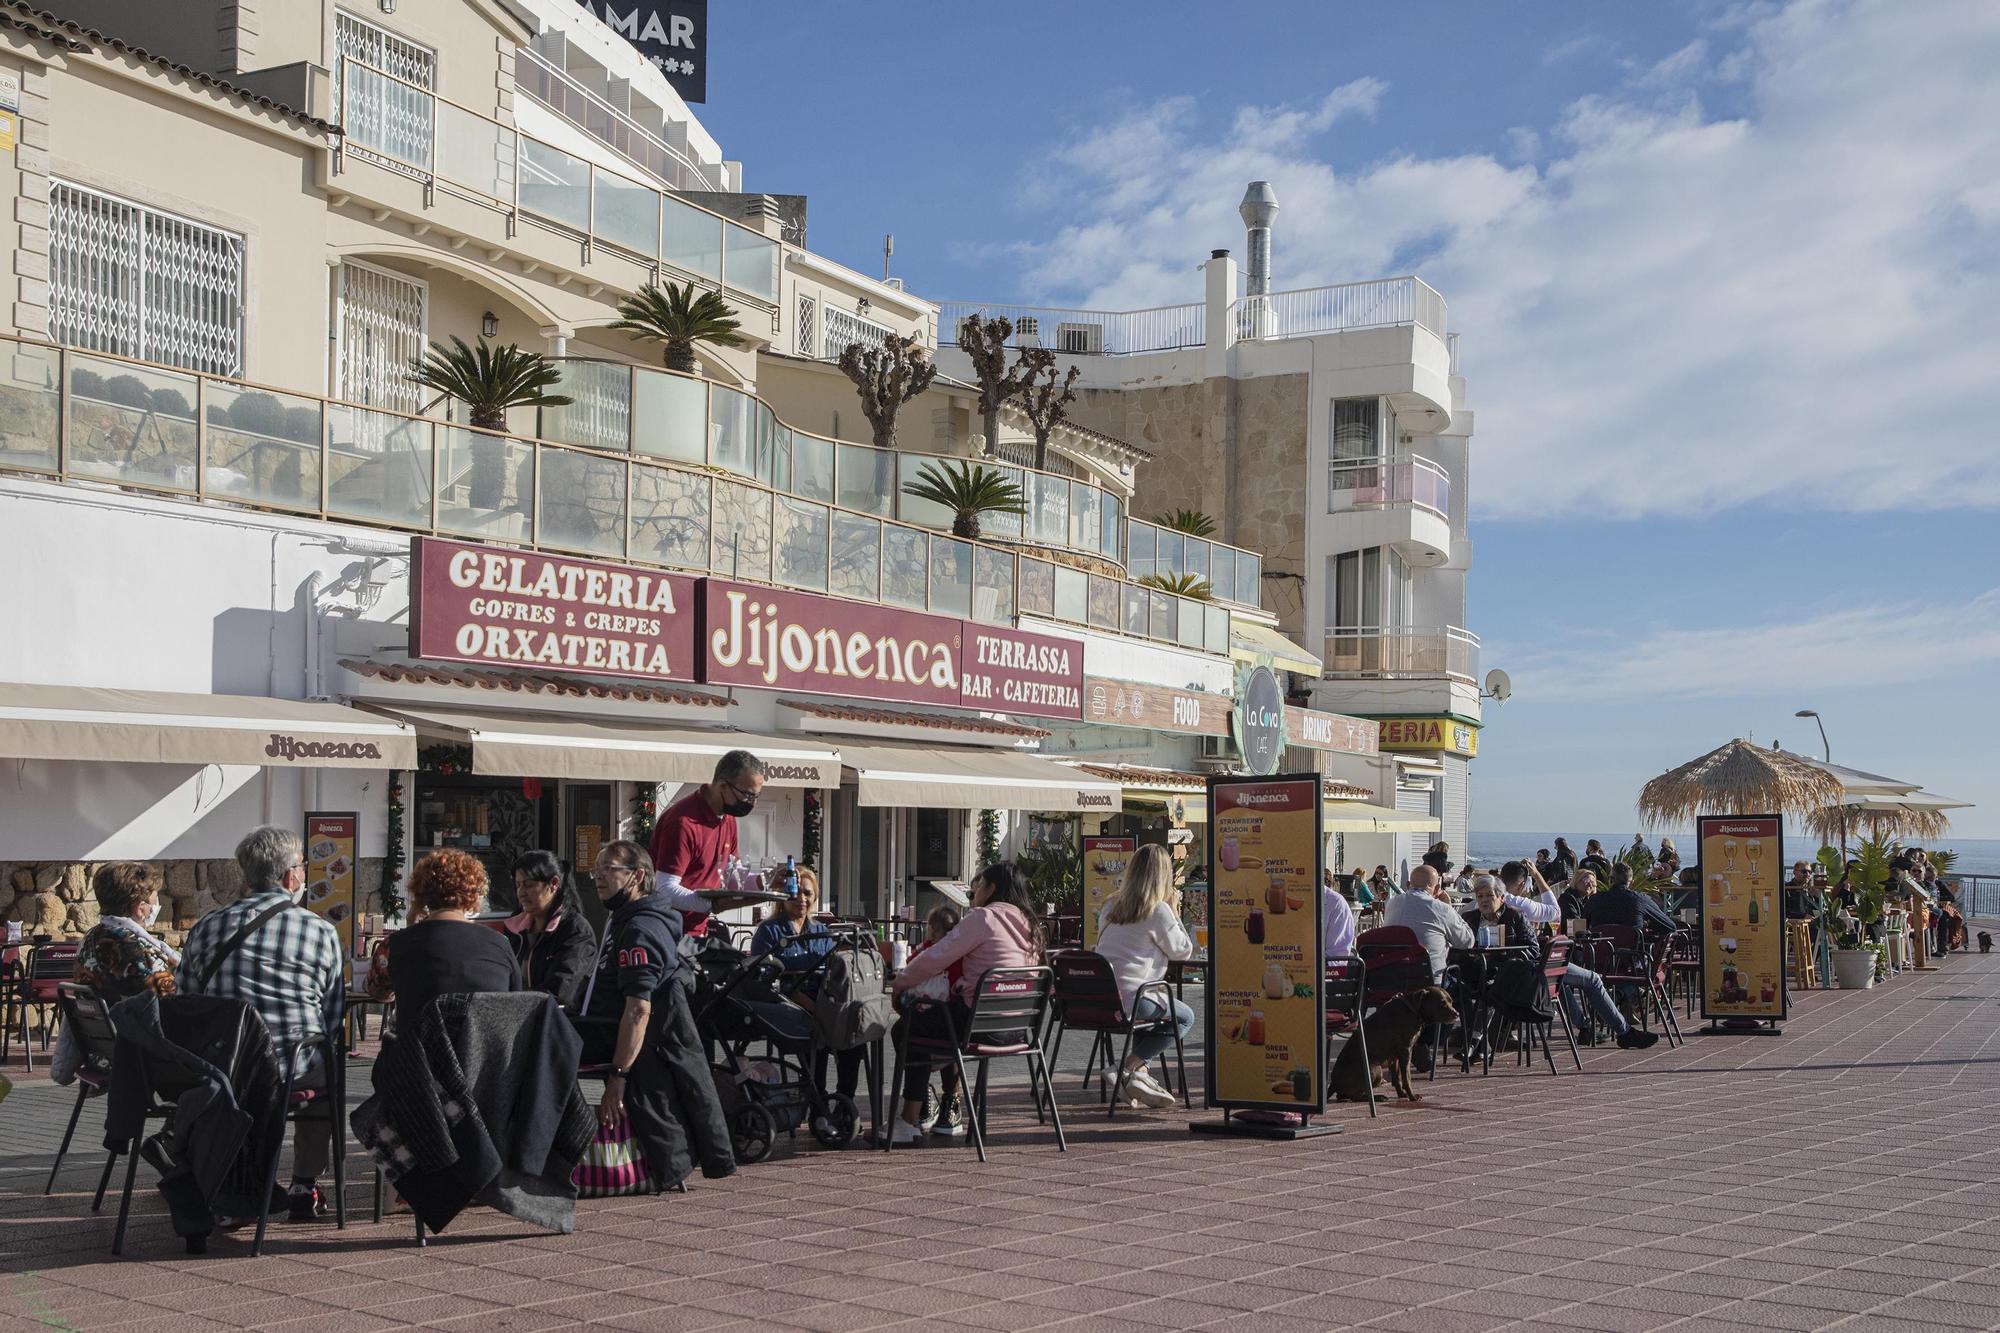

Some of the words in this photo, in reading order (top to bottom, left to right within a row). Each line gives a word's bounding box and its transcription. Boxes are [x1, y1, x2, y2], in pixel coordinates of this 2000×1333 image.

[449, 550, 676, 614] GELATERIA
[469, 597, 556, 624] GOFRES
[565, 612, 576, 627] &
[584, 611, 661, 636] CREPES
[455, 623, 671, 674] ORXATERIA
[977, 635, 1070, 675] TERRASSA
[961, 673, 992, 698] BAR
[1003, 679, 1079, 708] CAFETERIA
[1174, 696, 1200, 726] FOOD
[1247, 704, 1257, 726] La
[1259, 705, 1278, 727] Cova
[1303, 716, 1331, 743] DRINKS
[265, 734, 382, 761] Jijonenca
[1077, 791, 1112, 808] Jijonenca
[1236, 792, 1289, 805] Jijonenca
[1219, 817, 1264, 825] STRAWBERRY
[1719, 825, 1759, 834] Jijonenca
[1265, 867, 1295, 875] DREAMS
[996, 983, 1027, 992] Jijonenca
